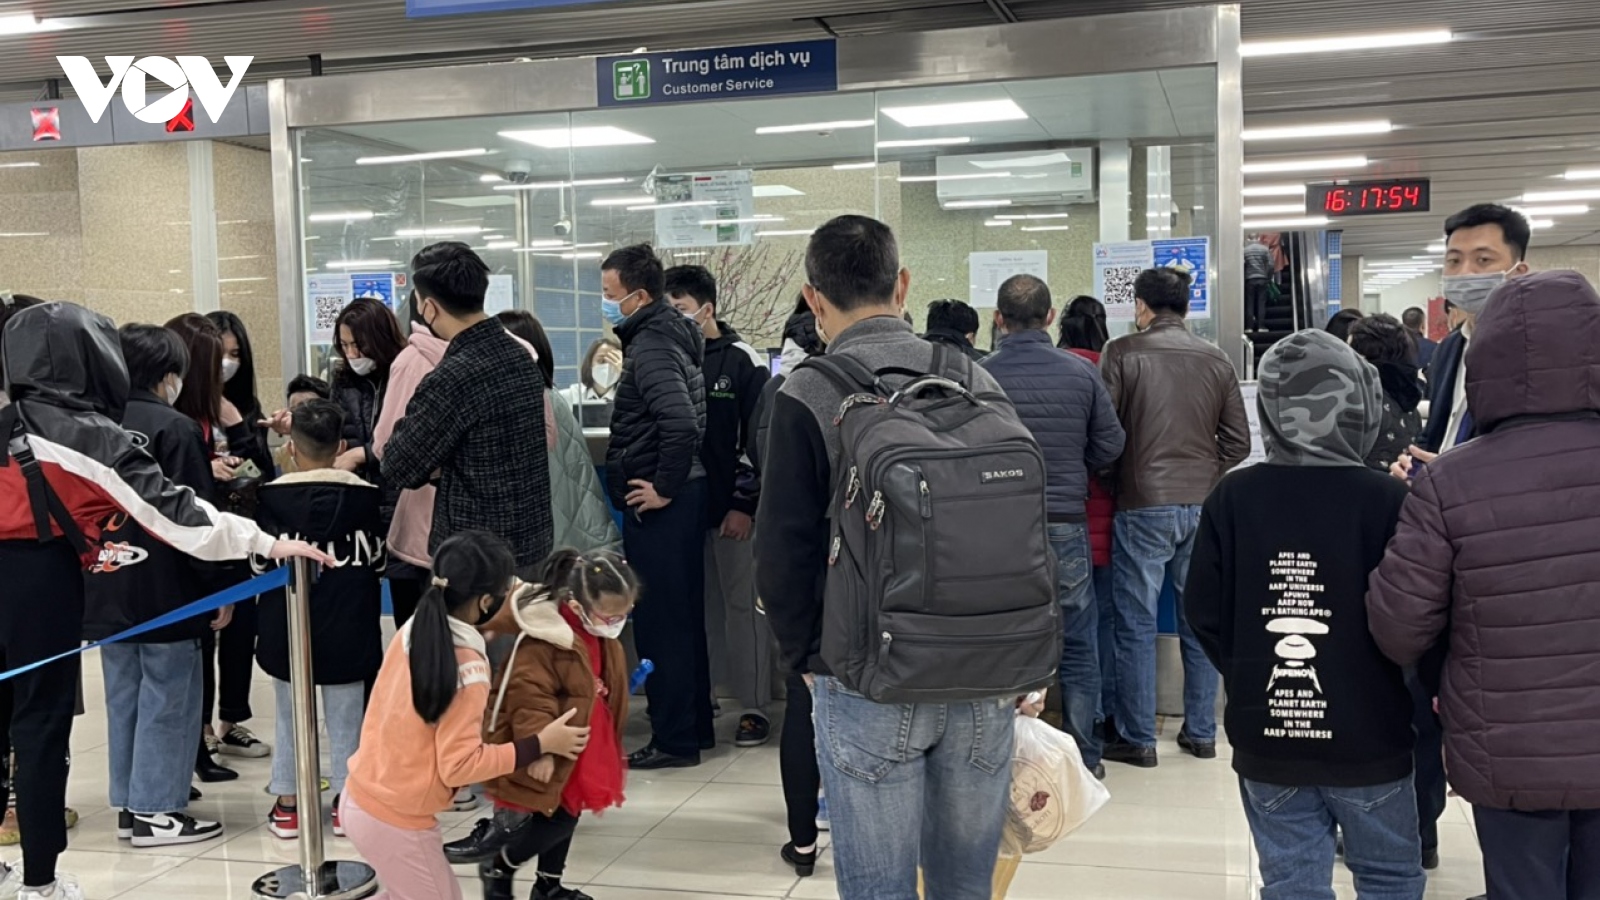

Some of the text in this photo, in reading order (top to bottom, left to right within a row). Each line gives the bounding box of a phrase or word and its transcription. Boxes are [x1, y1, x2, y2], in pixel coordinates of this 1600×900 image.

[662, 50, 811, 76] Trung tâm dịch vụ
[662, 77, 775, 96] Customer Service
[1325, 186, 1419, 211] 16:17:54
[1297, 552, 1311, 560] AND
[1296, 560, 1318, 568] EARTH
[1271, 568, 1315, 576] SOMEWHERE
[1295, 575, 1308, 583] THE
[1289, 583, 1325, 592] UNIVERSE
[1297, 599, 1315, 607] NOW
[1277, 607, 1309, 616] BATHING
[1274, 689, 1314, 698] APES AND
[1268, 698, 1328, 709] PLANET EARTH
[1269, 708, 1325, 719] SOMEWHERE
[1283, 719, 1311, 729] IN THE
[1288, 729, 1333, 739] UNIVERSE
